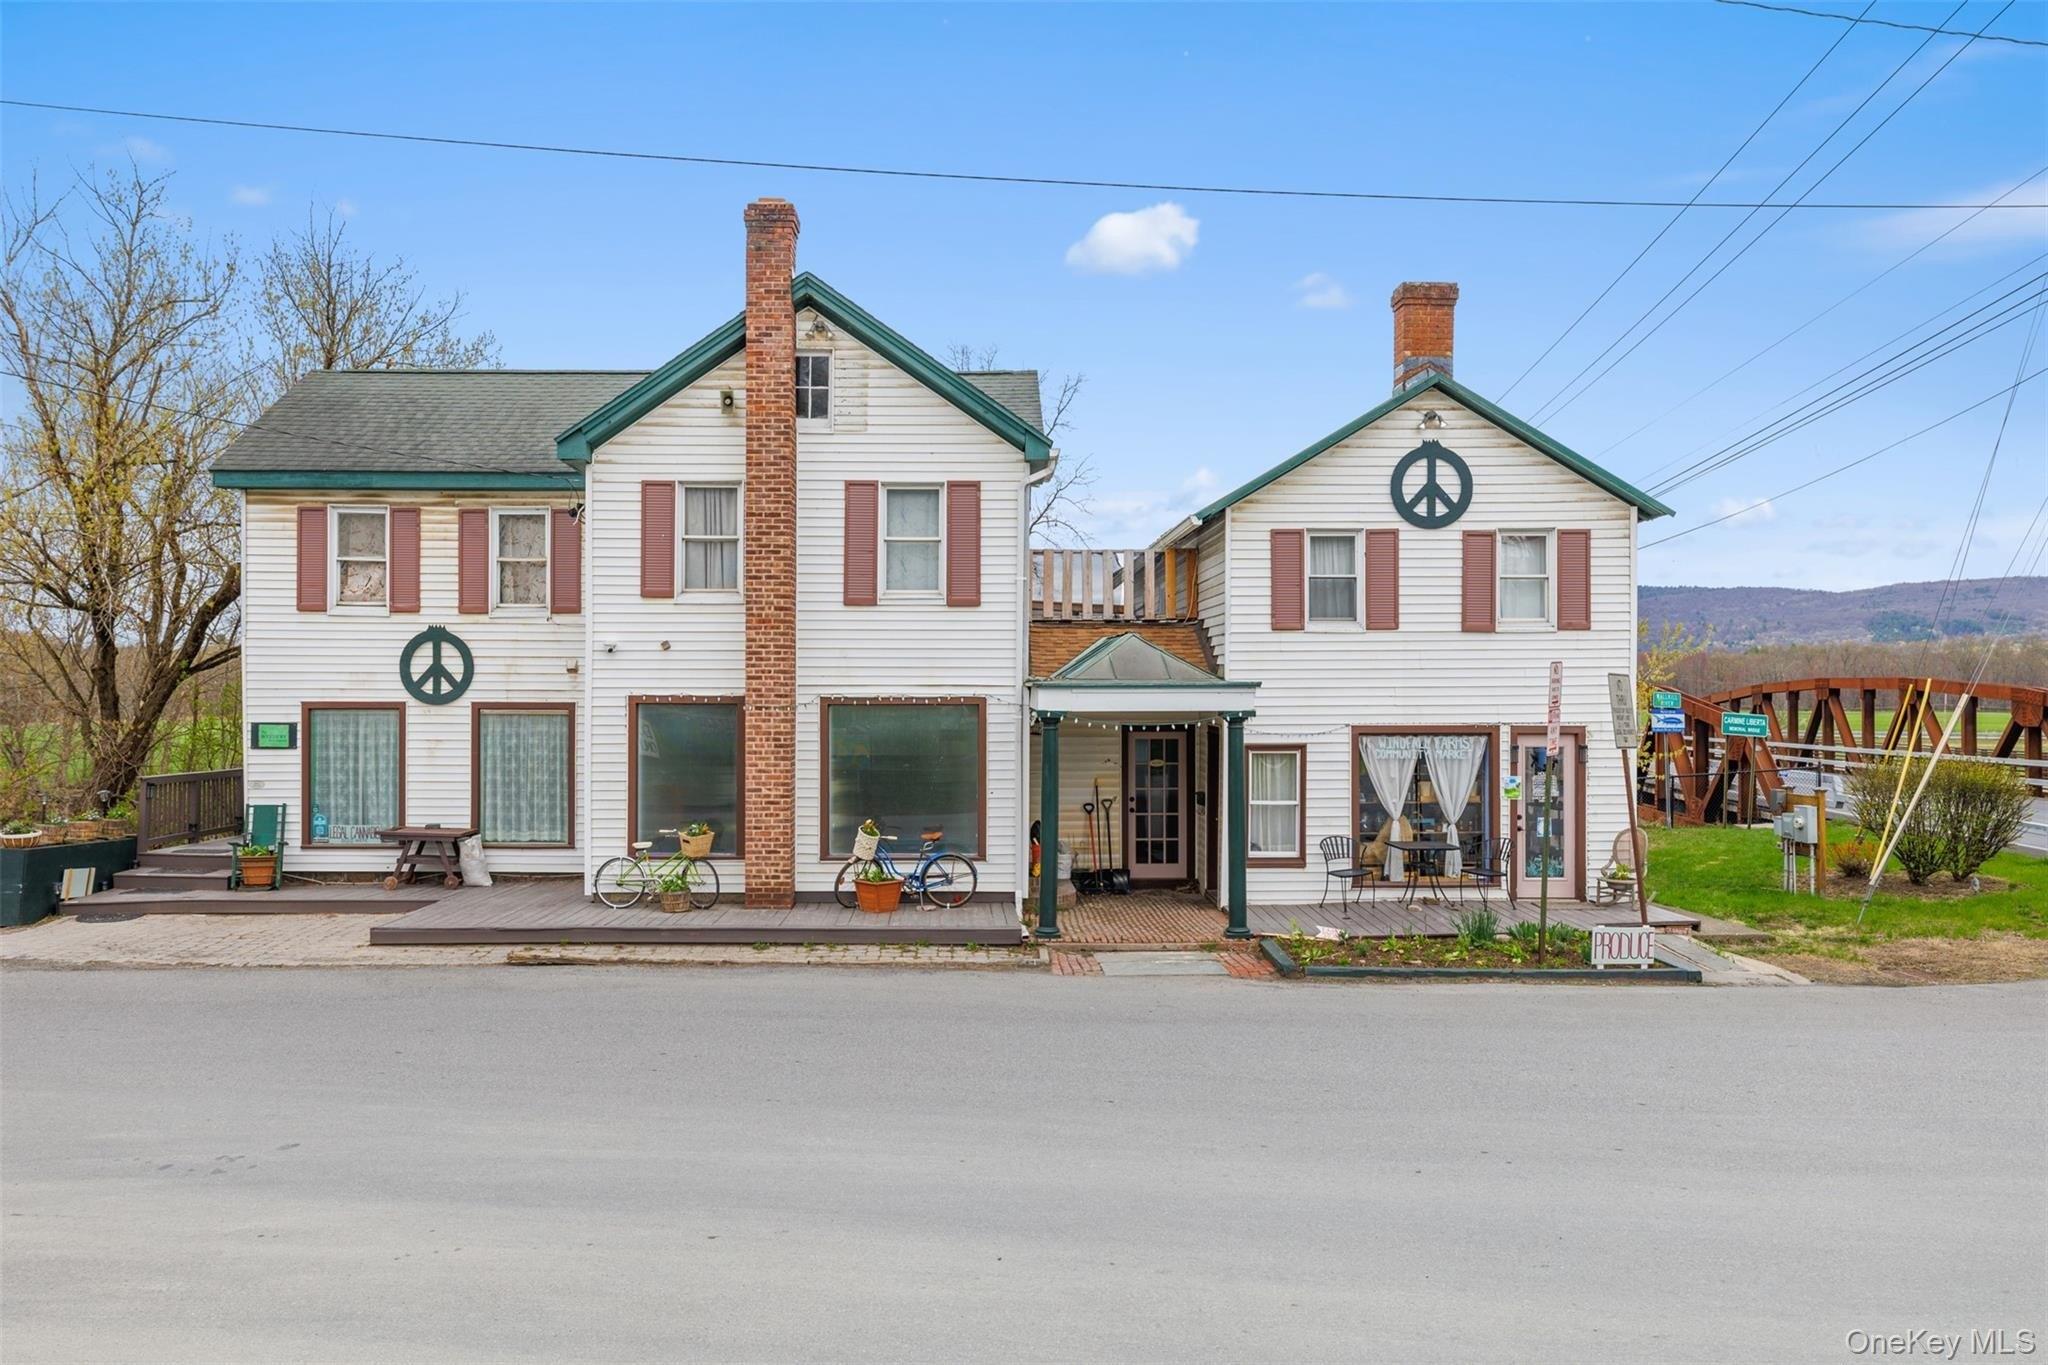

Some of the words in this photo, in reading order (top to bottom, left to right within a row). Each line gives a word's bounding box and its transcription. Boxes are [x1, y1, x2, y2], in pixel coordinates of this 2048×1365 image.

[1724, 716, 1746, 726] CARMINE
[1746, 718, 1766, 726] LIBERTA
[1435, 736, 1470, 749] FARMS
[1375, 749, 1431, 760] COMMUNITY
[1436, 749, 1473, 760] MARKET
[1594, 931, 1654, 960] PRODUCE
